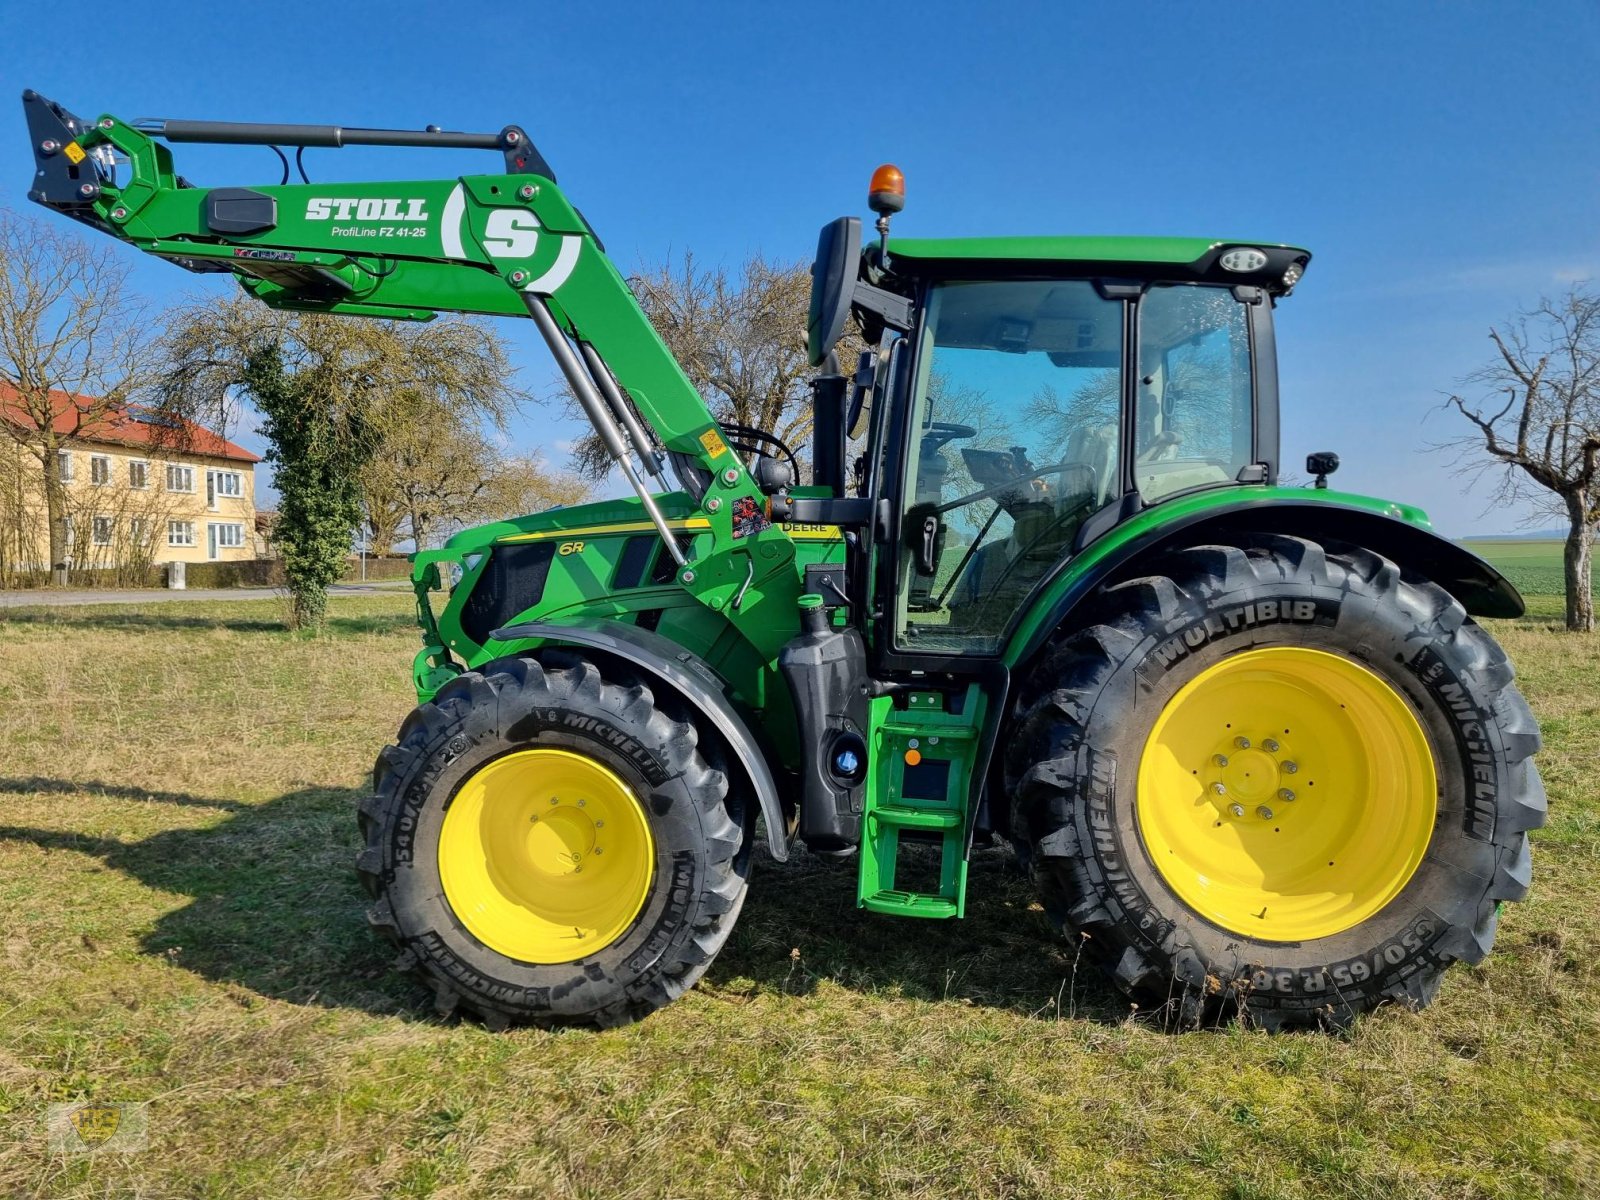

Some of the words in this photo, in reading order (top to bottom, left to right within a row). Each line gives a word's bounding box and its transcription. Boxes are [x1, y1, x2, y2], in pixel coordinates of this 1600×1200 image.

[305, 198, 429, 221] STOLL
[332, 226, 377, 237] ProfiLine
[379, 227, 394, 237] FZ
[396, 227, 426, 237] 41-25
[782, 522, 827, 532] DEERE
[559, 541, 585, 556] 6R
[1152, 600, 1317, 667] MULTIBIB
[1439, 682, 1496, 843] MICHELIN
